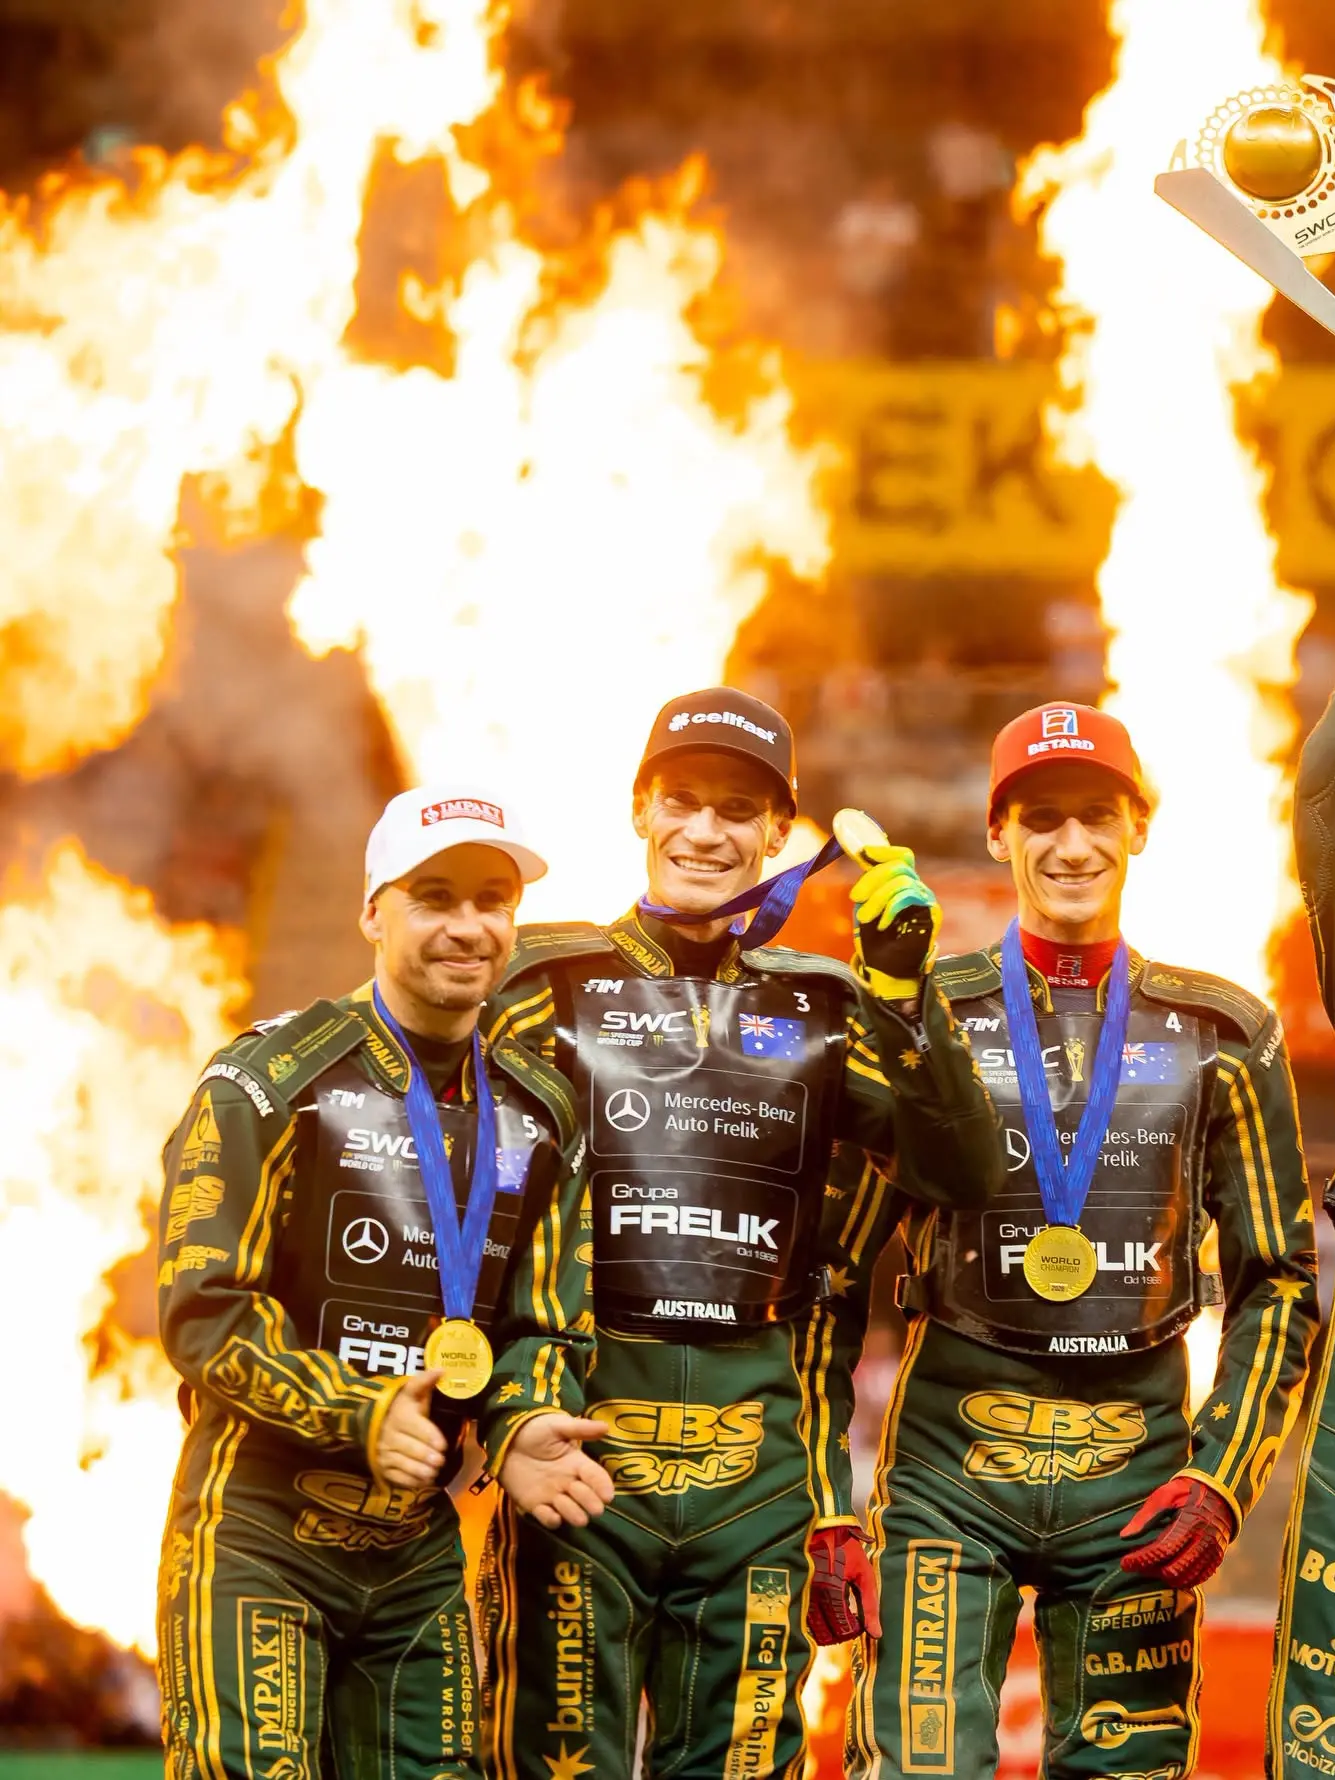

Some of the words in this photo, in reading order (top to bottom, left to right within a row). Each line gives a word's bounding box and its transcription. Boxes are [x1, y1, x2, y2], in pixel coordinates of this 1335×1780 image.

[691, 711, 776, 745] cellfast
[1027, 737, 1095, 756] BETARD
[611, 931, 668, 976] AUSTRALIA
[582, 979, 624, 995] FIM
[791, 991, 811, 1013] 3
[601, 1010, 688, 1033] SWC
[961, 1018, 1000, 1032] FIM
[1165, 1012, 1183, 1033] 4
[326, 1089, 366, 1110] FIM
[664, 1091, 797, 1124] Mercedes-Benz
[521, 1114, 540, 1140] 5
[664, 1114, 709, 1133] Auto
[713, 1118, 760, 1140] Frelik
[611, 1183, 679, 1200] Grupa
[402, 1225, 511, 1260] MerBenz
[610, 1204, 780, 1250] FRELIK
[1000, 1223, 1045, 1239] Gru
[736, 1247, 753, 1258] Od
[1000, 1241, 1163, 1274] FLIK
[1040, 1264, 1079, 1274] CHAMPION
[1041, 1255, 1080, 1266] WORLD
[1123, 1275, 1139, 1285] Od
[342, 1314, 409, 1339] Grupa
[652, 1299, 737, 1322] AUSTRALIA
[339, 1336, 426, 1376] FRE
[441, 1351, 478, 1361] WORLD
[1048, 1336, 1130, 1354] AUSTRALIA
[585, 1400, 765, 1452] CBS
[960, 1391, 1147, 1446] CBS
[601, 1449, 757, 1495] BINS
[963, 1442, 1134, 1484] BINS
[911, 1555, 949, 1699] ENTRACK
[1091, 1610, 1174, 1633] SPEEDWAY
[438, 1613, 454, 1678] GRUPA
[547, 1560, 584, 1733] burnside
[757, 1629, 783, 1666] Ice
[1085, 1651, 1133, 1677] G.B.
[1135, 1639, 1193, 1673] AUTO
[253, 1609, 285, 1751] IMPAKT
[582, 1657, 595, 1732] chartered
[286, 1676, 300, 1753] PDUCENT
[441, 1687, 454, 1766] WRÓBE
[742, 1675, 776, 1780] Machin
